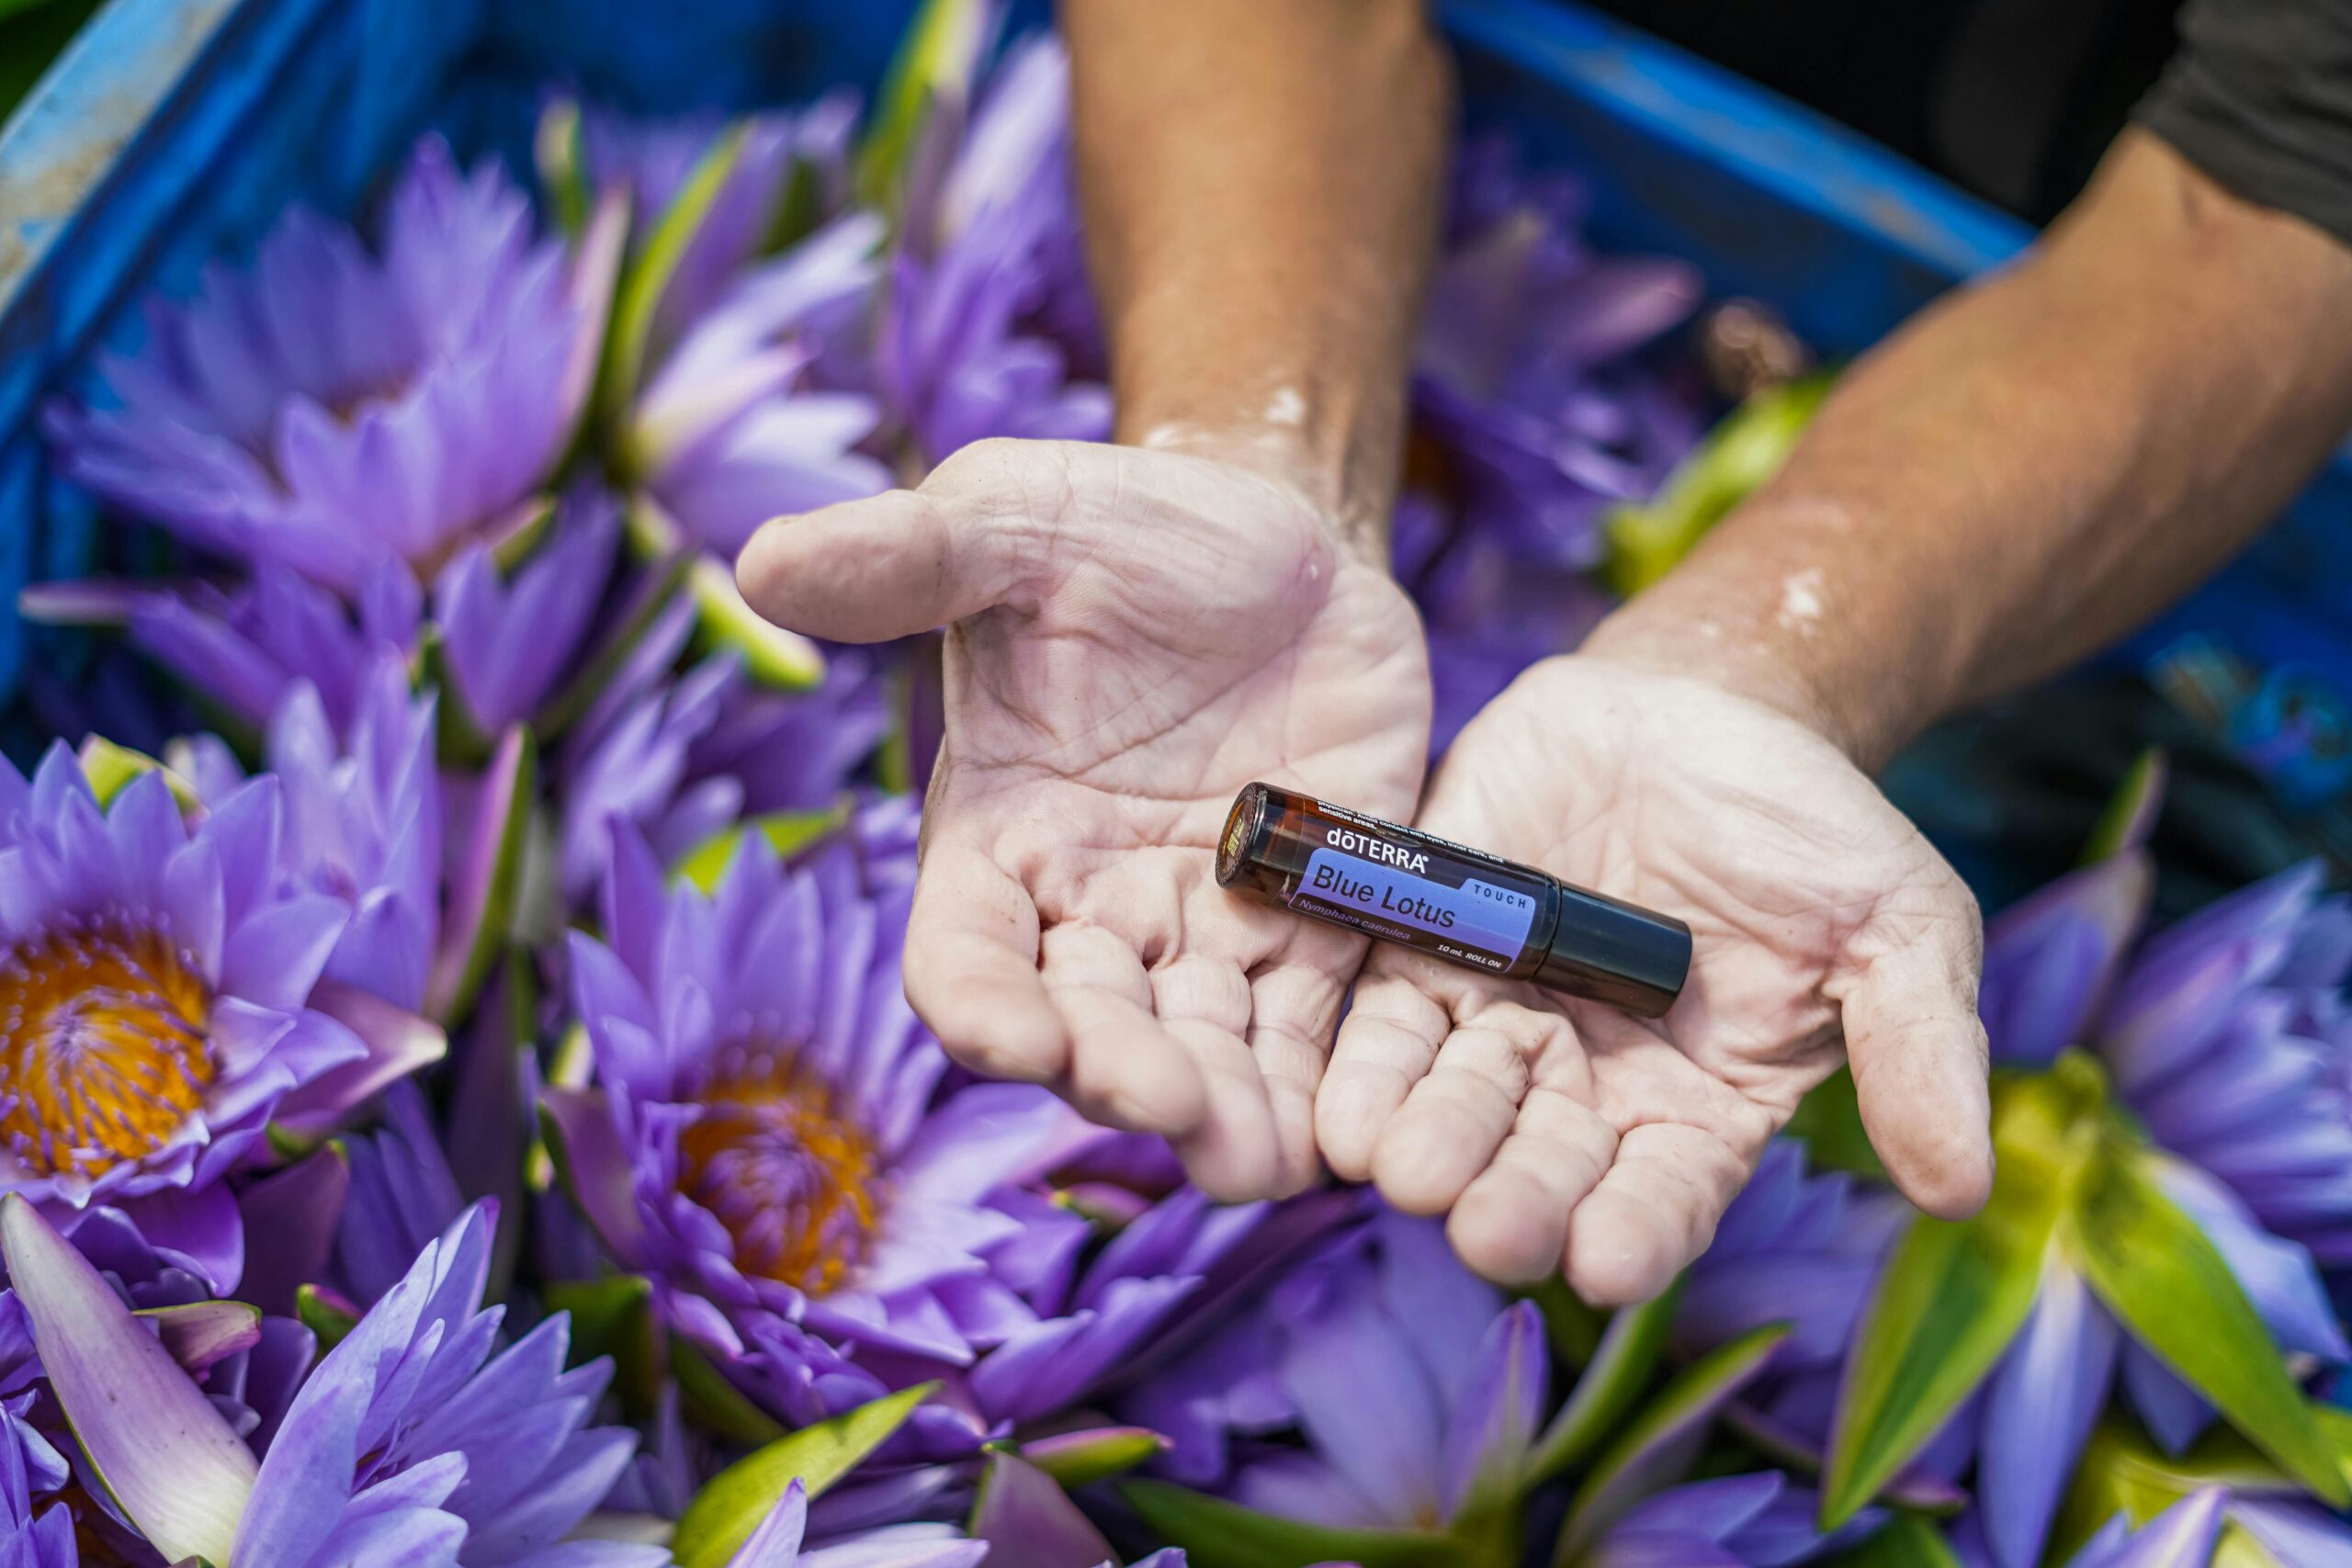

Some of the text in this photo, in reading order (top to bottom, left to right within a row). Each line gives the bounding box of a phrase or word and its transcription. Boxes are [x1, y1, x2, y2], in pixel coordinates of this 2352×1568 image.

[1317, 806, 1377, 829] sensitive areas.
[1379, 820, 1408, 833] contact
[1408, 829, 1426, 839] with
[1488, 853, 1503, 863] and
[1312, 863, 1455, 928] Blue Lotus
[1474, 884, 1526, 908] TOUCH
[1299, 899, 1410, 940] Nymphaea caerulea
[1437, 944, 1502, 968] 10 mL ROLL ON
